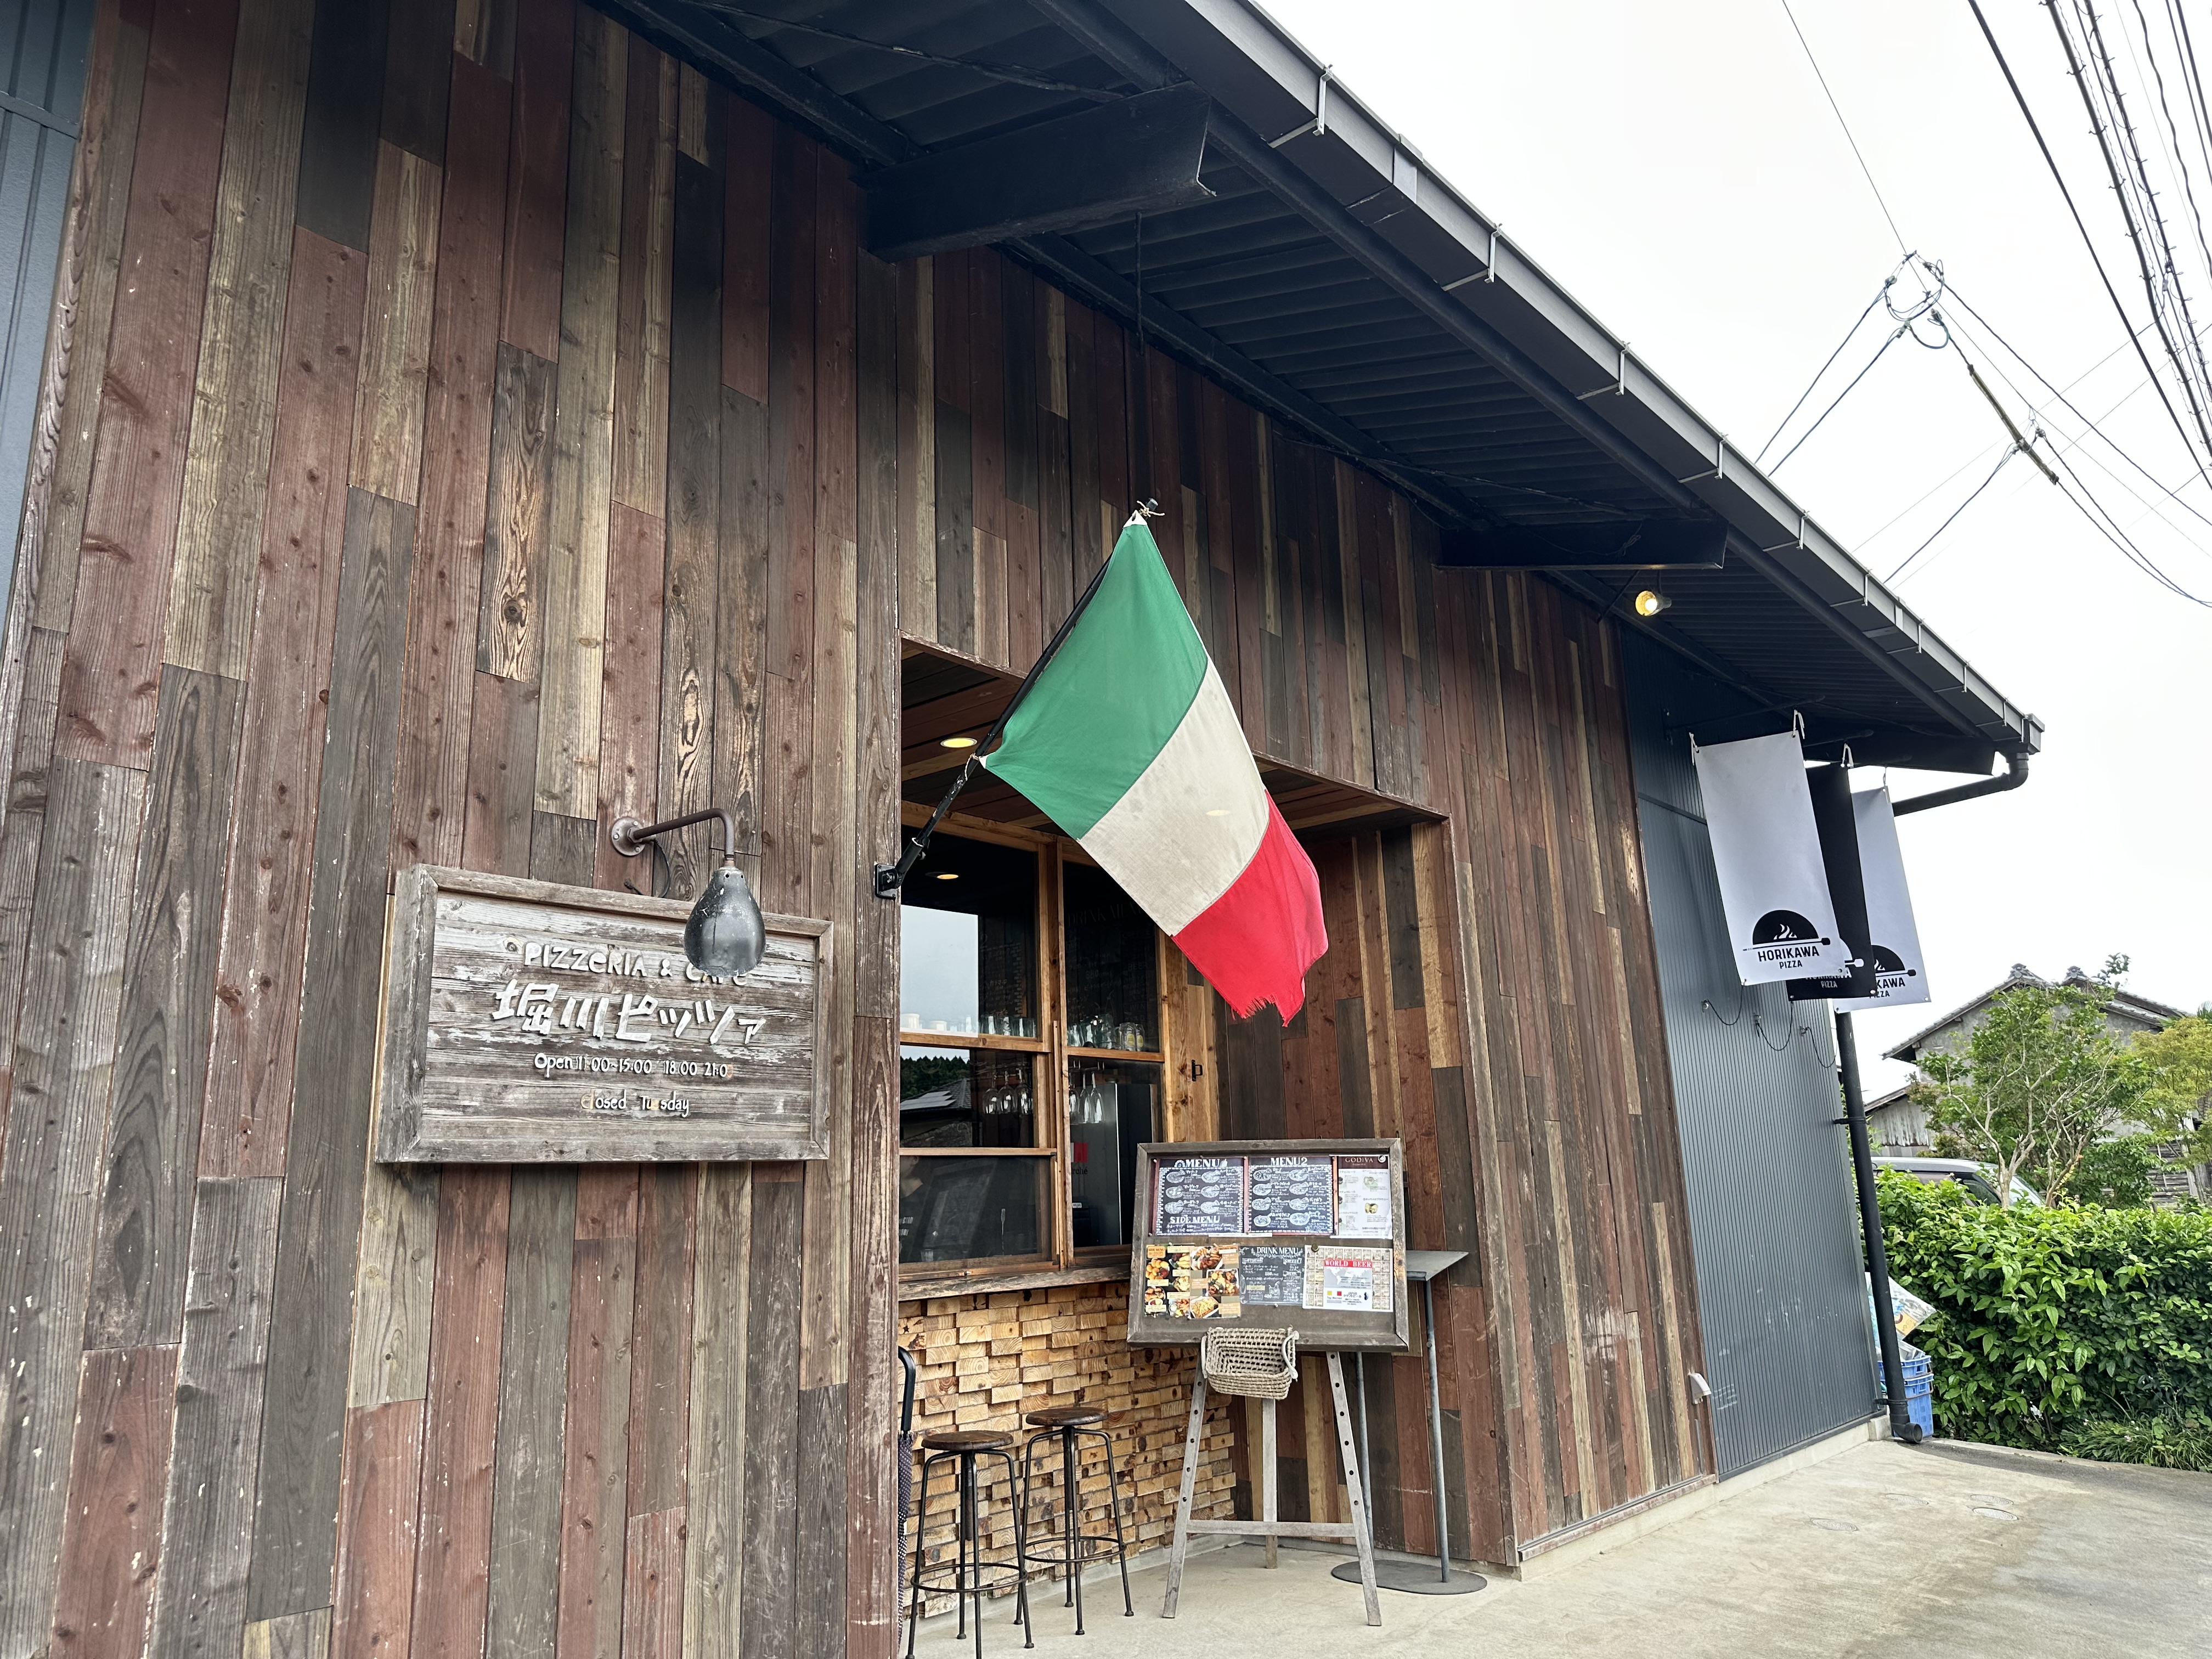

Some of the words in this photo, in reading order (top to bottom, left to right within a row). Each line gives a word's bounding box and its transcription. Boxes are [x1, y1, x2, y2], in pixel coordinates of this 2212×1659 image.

[1757, 945, 1820, 962] HORIKAWA
[660, 958, 674, 977] &
[1779, 960, 1803, 969] PIZZA
[1820, 980, 1838, 989] PIZZA
[1876, 977, 1906, 989] KAWA
[1869, 990, 1891, 999] ZZA
[492, 978, 767, 1045] 堀川ピッツァ
[534, 1052, 573, 1078] Open
[639, 1090, 689, 1118] Tusday
[1185, 1159, 1220, 1167] MENU
[1072, 1166, 1088, 1175] rché
[1192, 1215, 1220, 1223] MENU
